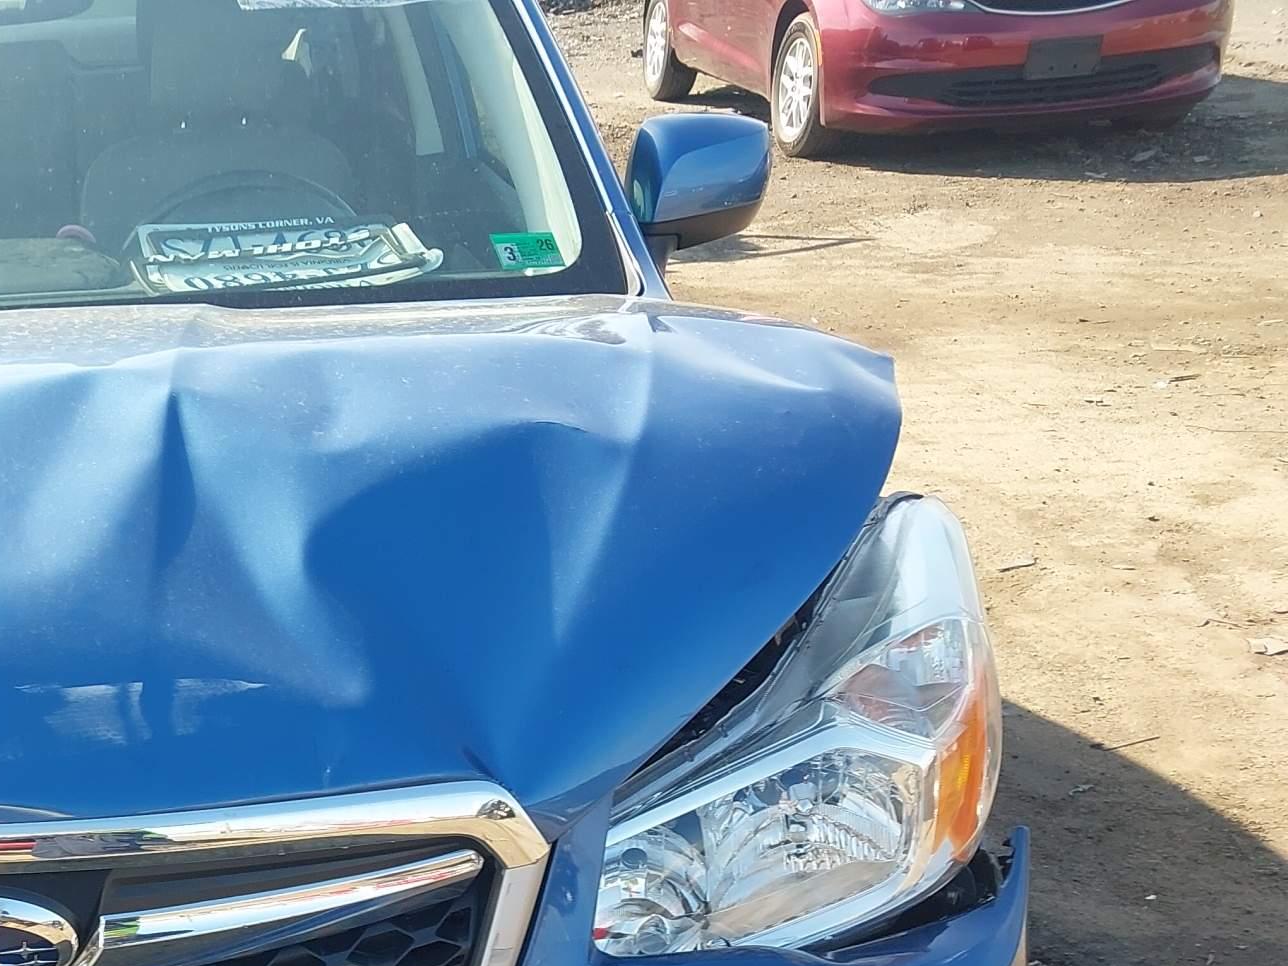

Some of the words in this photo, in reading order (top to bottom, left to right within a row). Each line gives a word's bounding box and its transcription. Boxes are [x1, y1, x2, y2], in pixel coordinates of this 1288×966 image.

[208, 222, 255, 233] TYSONS
[316, 216, 334, 224] VA
[537, 239, 554, 251] 26
[503, 246, 516, 262] 3
